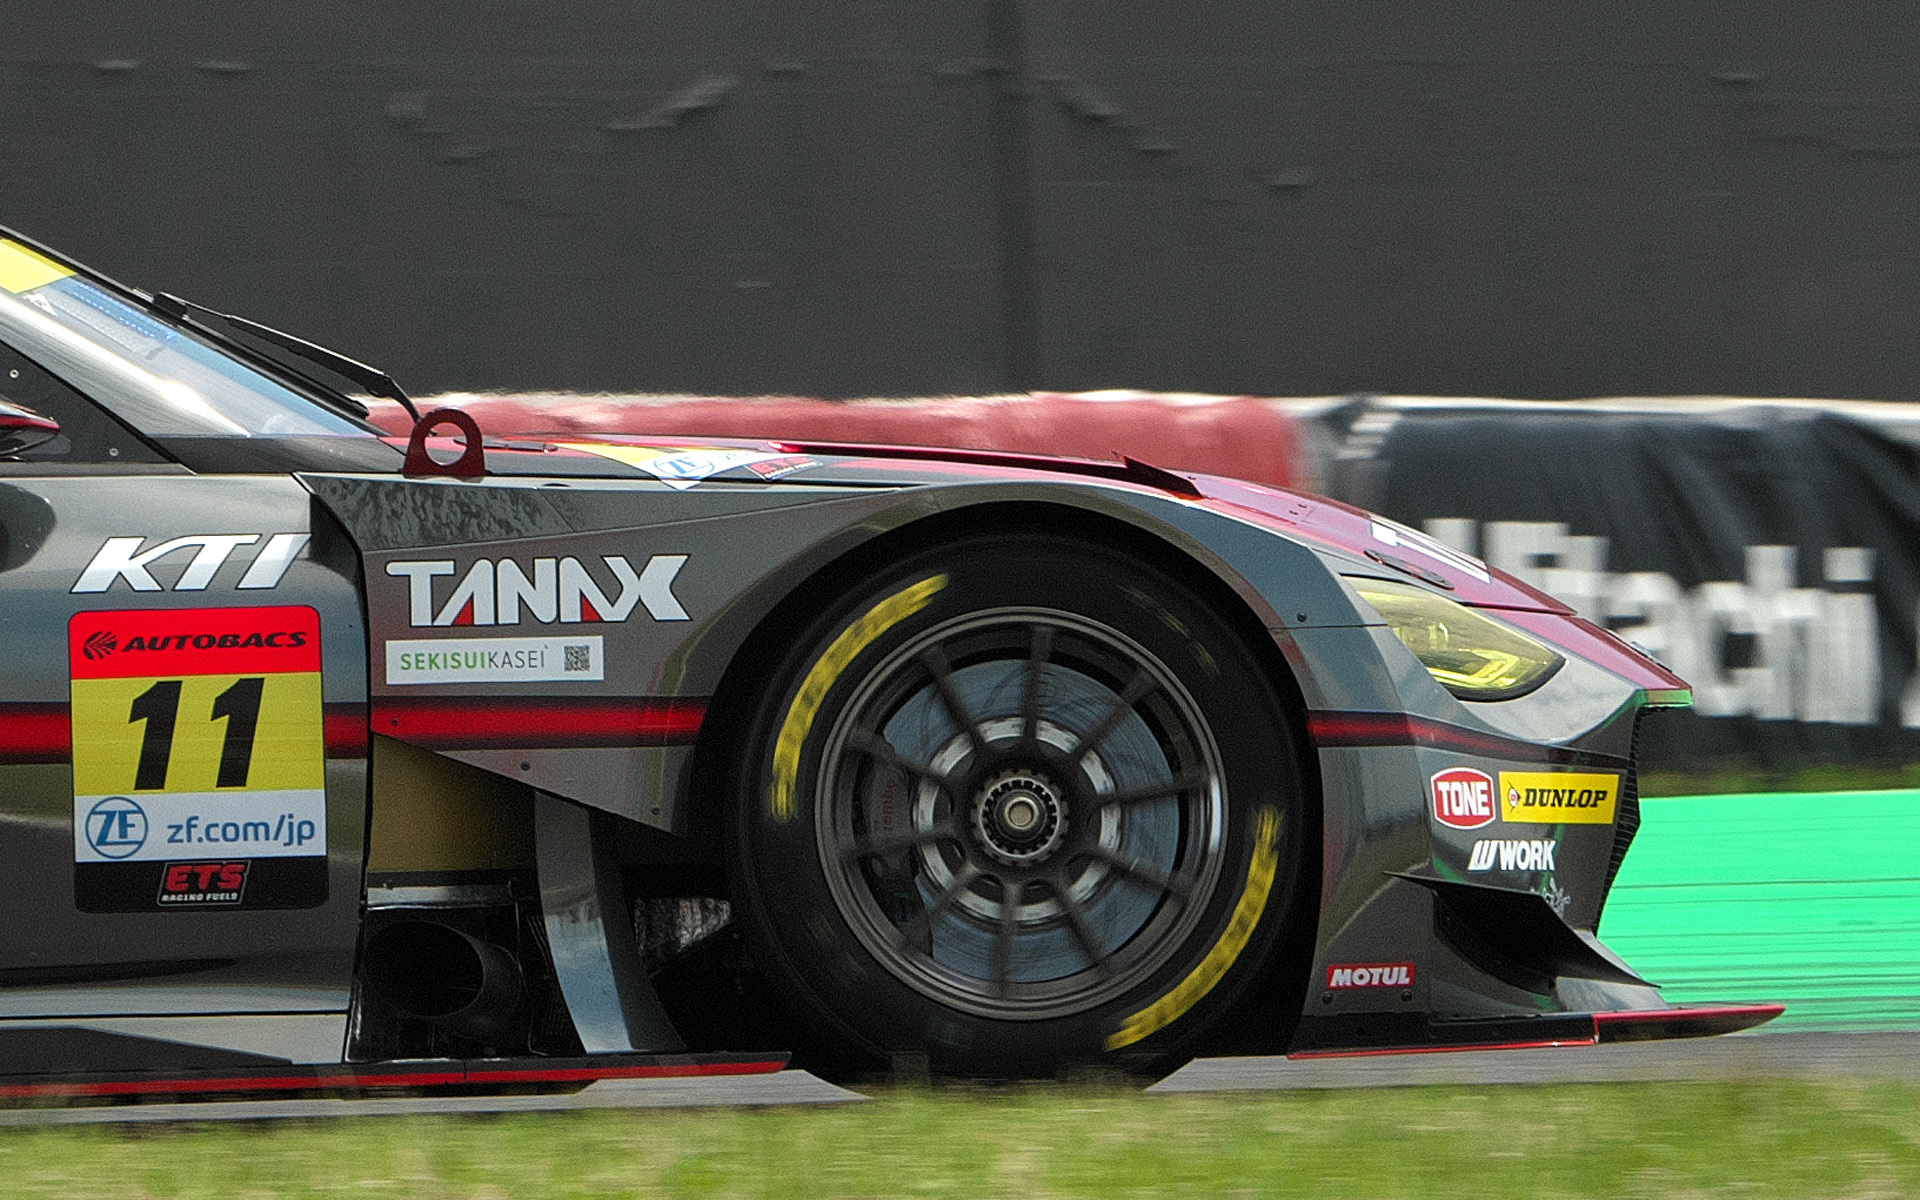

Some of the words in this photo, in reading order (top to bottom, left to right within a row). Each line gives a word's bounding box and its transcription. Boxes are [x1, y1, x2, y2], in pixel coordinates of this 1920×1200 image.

[70, 533, 312, 593] KTI
[386, 554, 693, 628] TANAX
[121, 631, 307, 653] AUTOBACS
[128, 677, 266, 791] 11
[1437, 781, 1491, 816] TONE
[1523, 788, 1608, 808] DUNLOP
[91, 806, 146, 849] ZF
[166, 813, 316, 847] zf.com/jp
[1499, 839, 1557, 871] WORK
[166, 864, 245, 891] ETS
[1330, 966, 1410, 987] MOTUL
